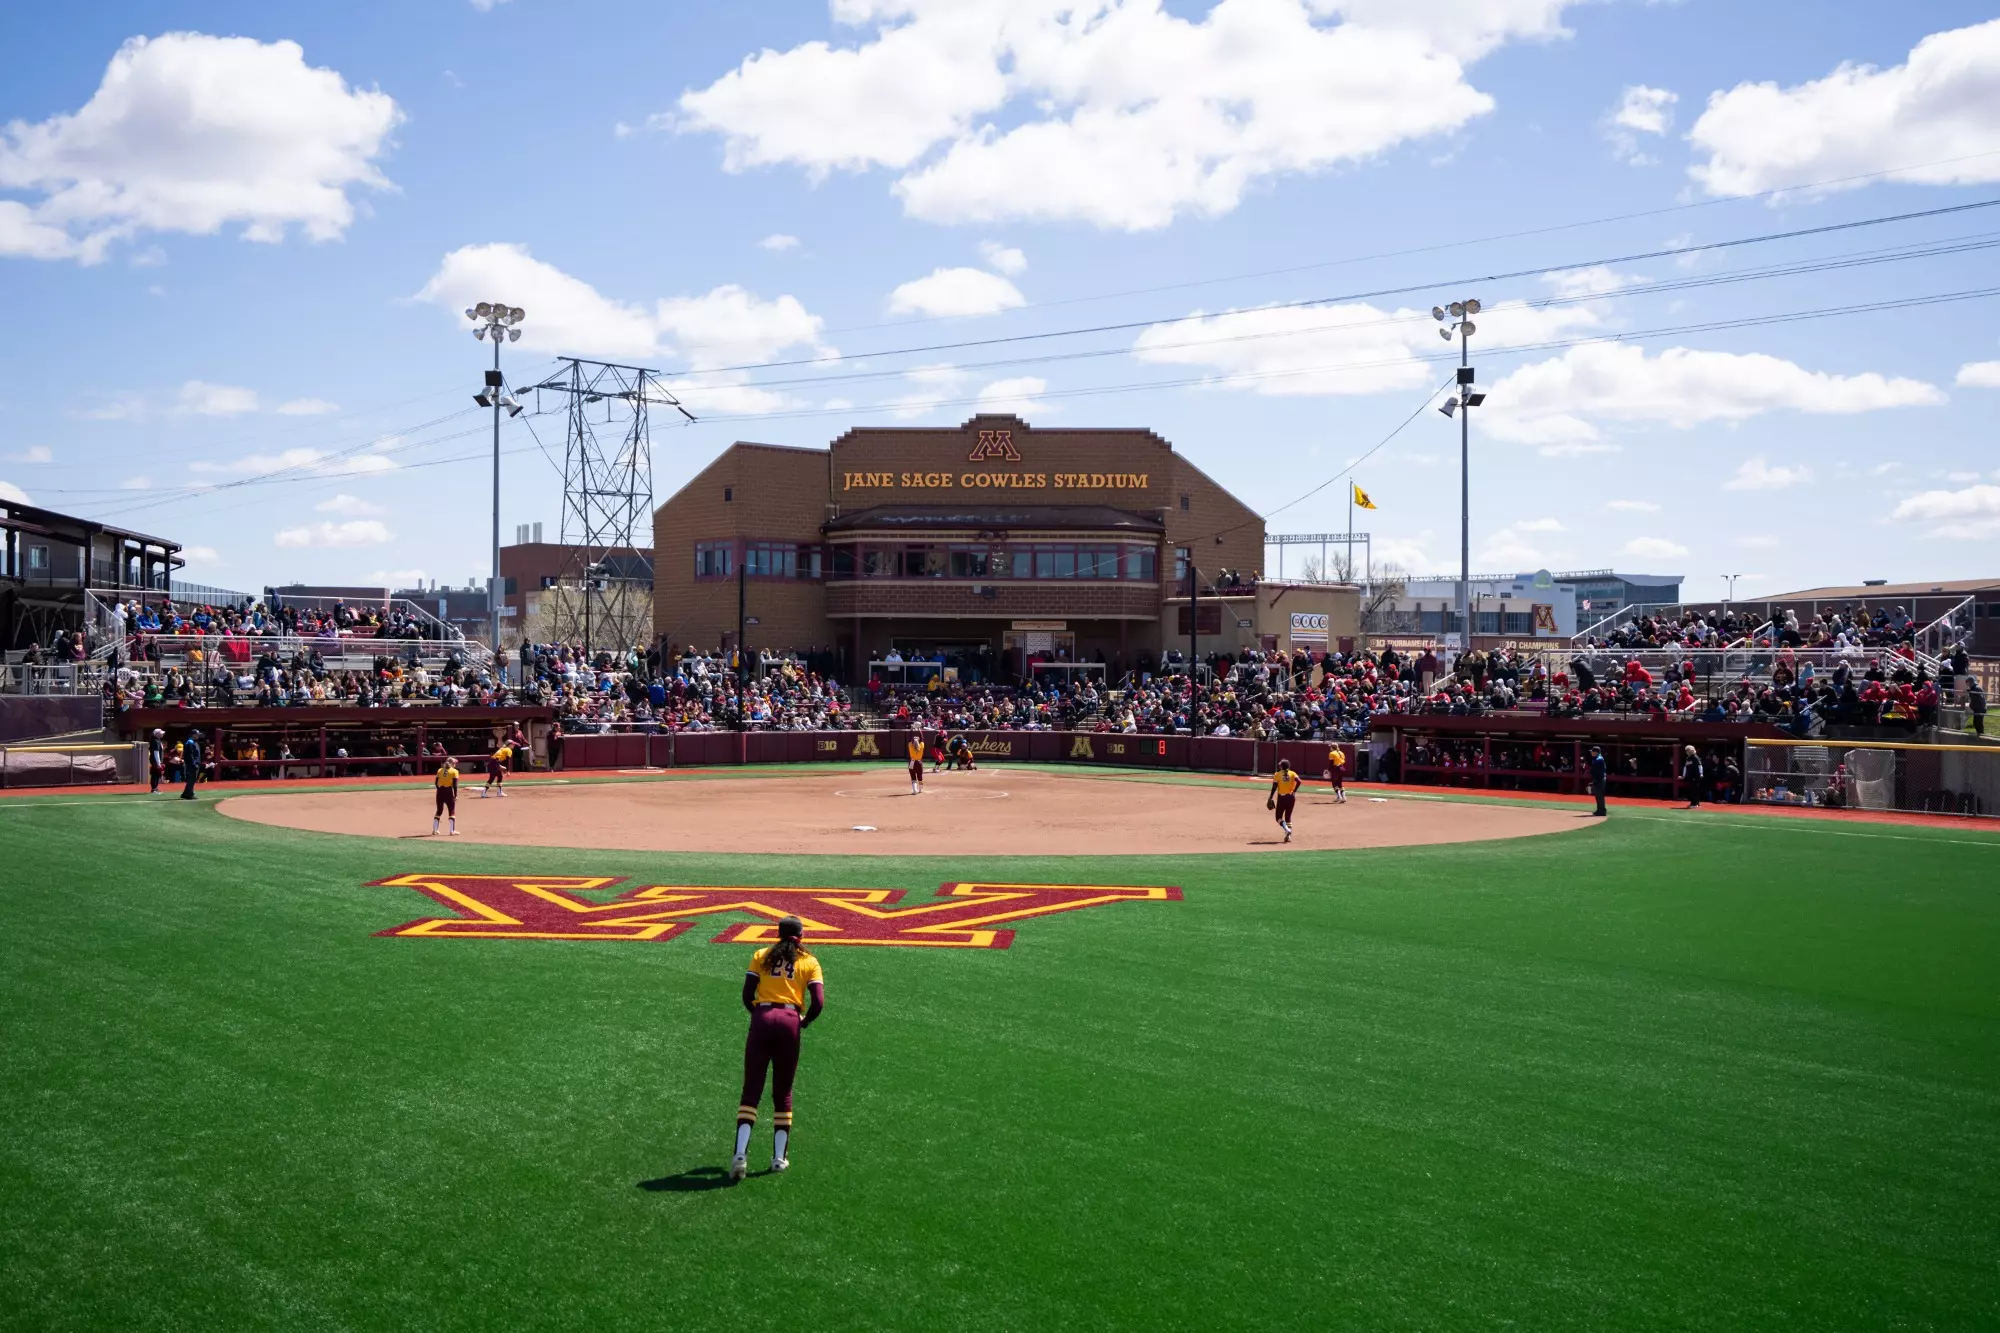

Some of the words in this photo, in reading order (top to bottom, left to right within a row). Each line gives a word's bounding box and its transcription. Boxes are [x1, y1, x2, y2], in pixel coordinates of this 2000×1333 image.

[969, 430, 1021, 461] M
[843, 472, 894, 491] JANE
[901, 472, 953, 488] SAGE
[960, 472, 1047, 488] COWLES
[1054, 473, 1149, 489] STADIUM
[945, 733, 1012, 756] Gphers
[770, 958, 795, 980] 24
